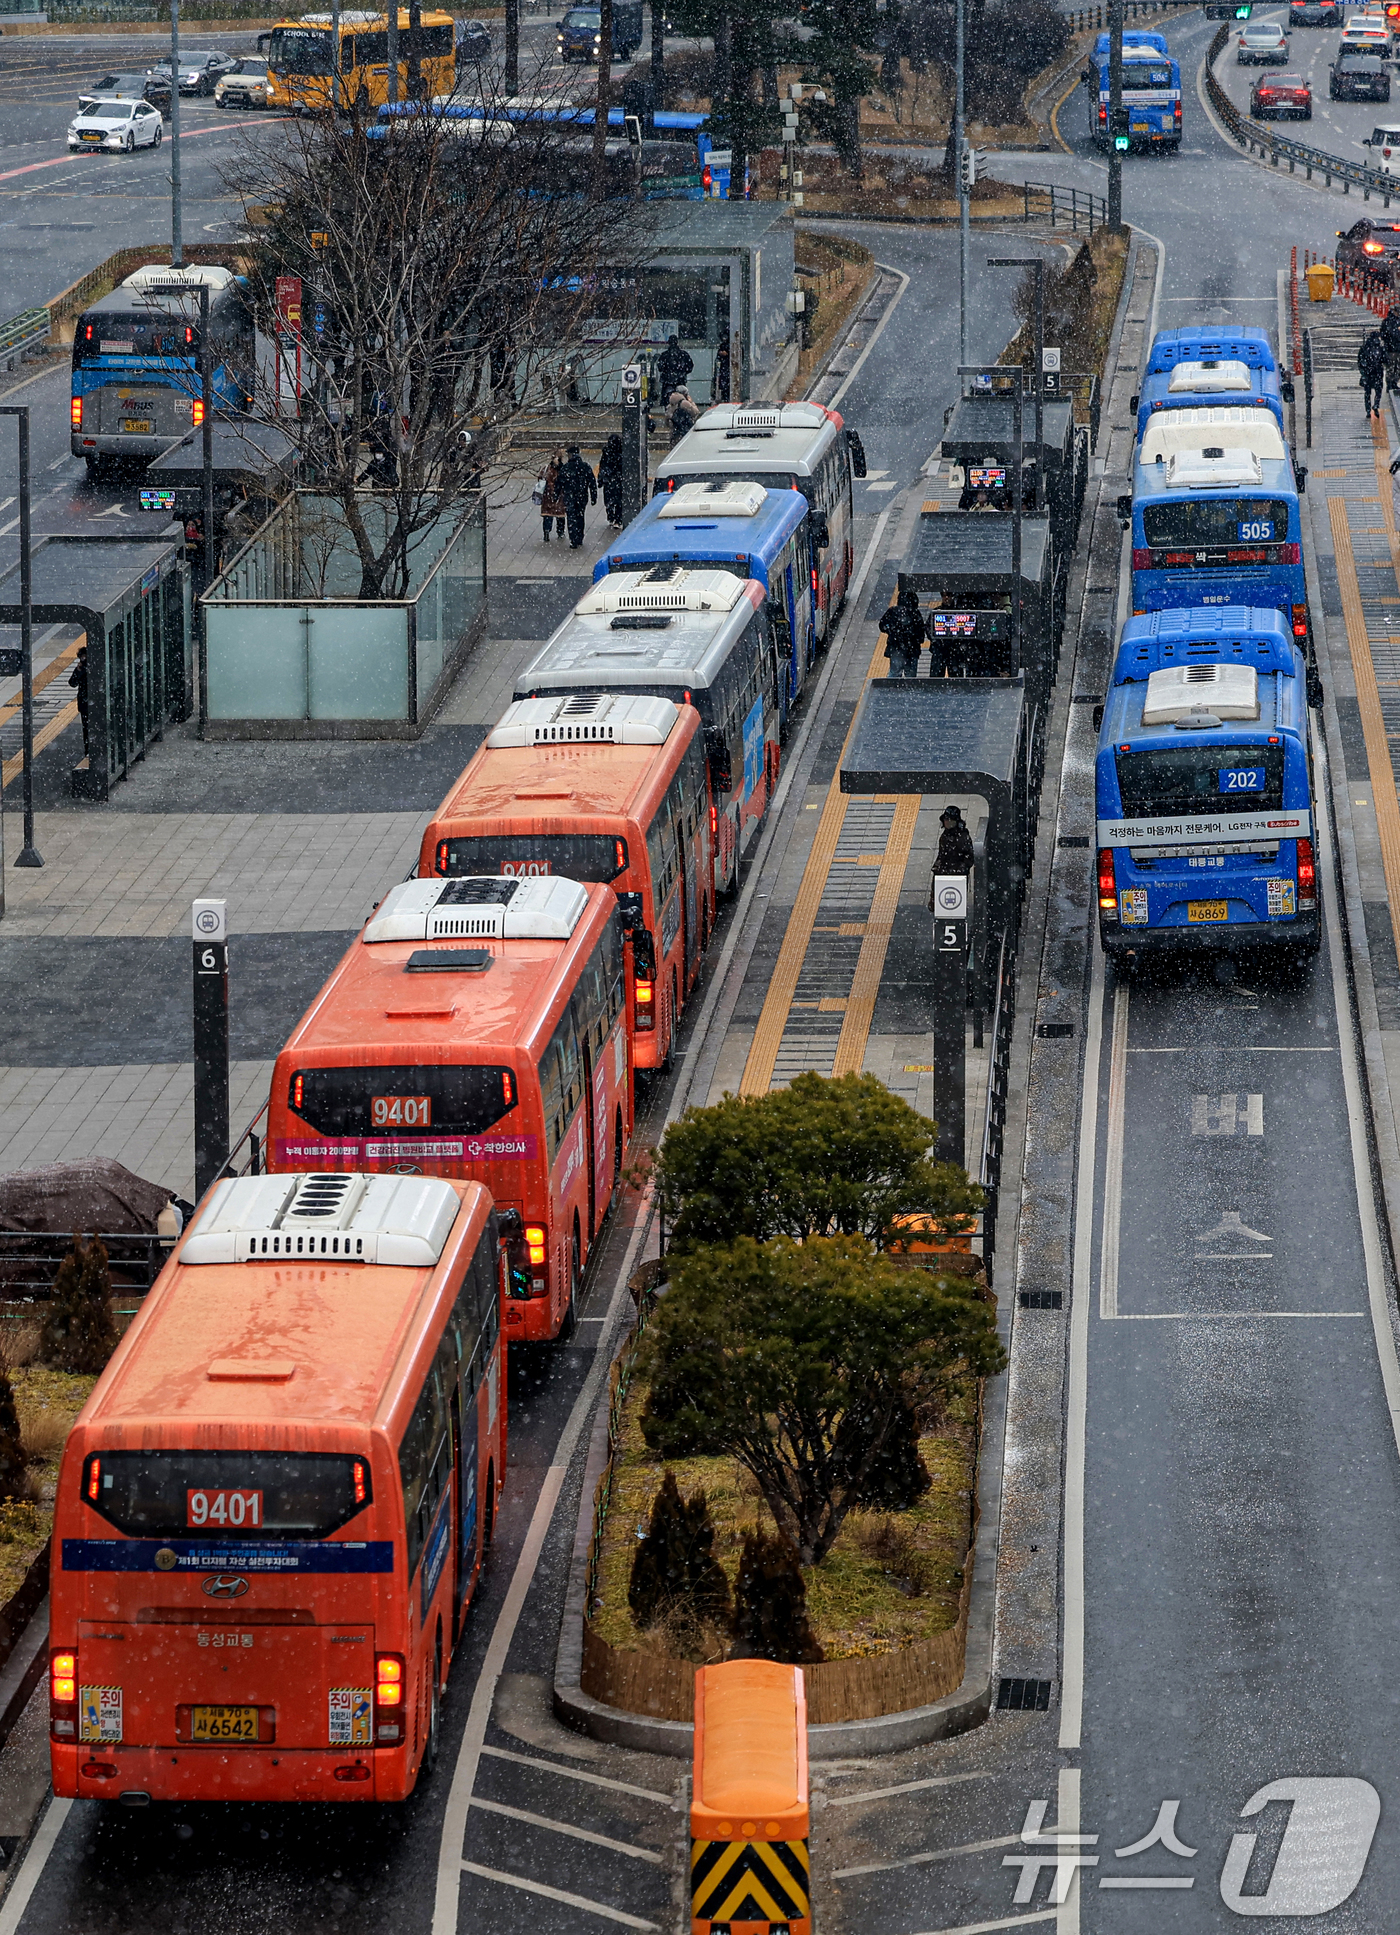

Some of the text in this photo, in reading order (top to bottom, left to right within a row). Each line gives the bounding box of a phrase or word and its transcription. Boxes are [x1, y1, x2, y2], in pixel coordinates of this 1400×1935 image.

[283, 30, 310, 38] SCHOOL
[1046, 375, 1055, 388] 5
[626, 392, 636, 404] 6
[1241, 522, 1271, 539] 505
[1227, 772, 1257, 788] 202
[1108, 825, 1144, 838] 걱정하는
[1147, 823, 1183, 836] 마음까지
[1228, 822, 1253, 831] LG전자
[1253, 821, 1266, 829] 구독
[1269, 882, 1281, 893] 주의
[1133, 891, 1146, 902] 주의
[943, 925, 957, 945] 5
[201, 948, 216, 969] 6
[374, 1099, 429, 1125] 9401
[286, 1146, 302, 1156] 누적
[483, 1142, 527, 1153] 착한의사
[191, 1492, 259, 1525] 9401
[178, 1557, 299, 1566] 제1회 디지털 자산 실전투자대회
[196, 1632, 254, 1648] 동성교통
[100, 1690, 121, 1708] 주의
[330, 1692, 351, 1710] 주의
[209, 1708, 242, 1718] 서울 70
